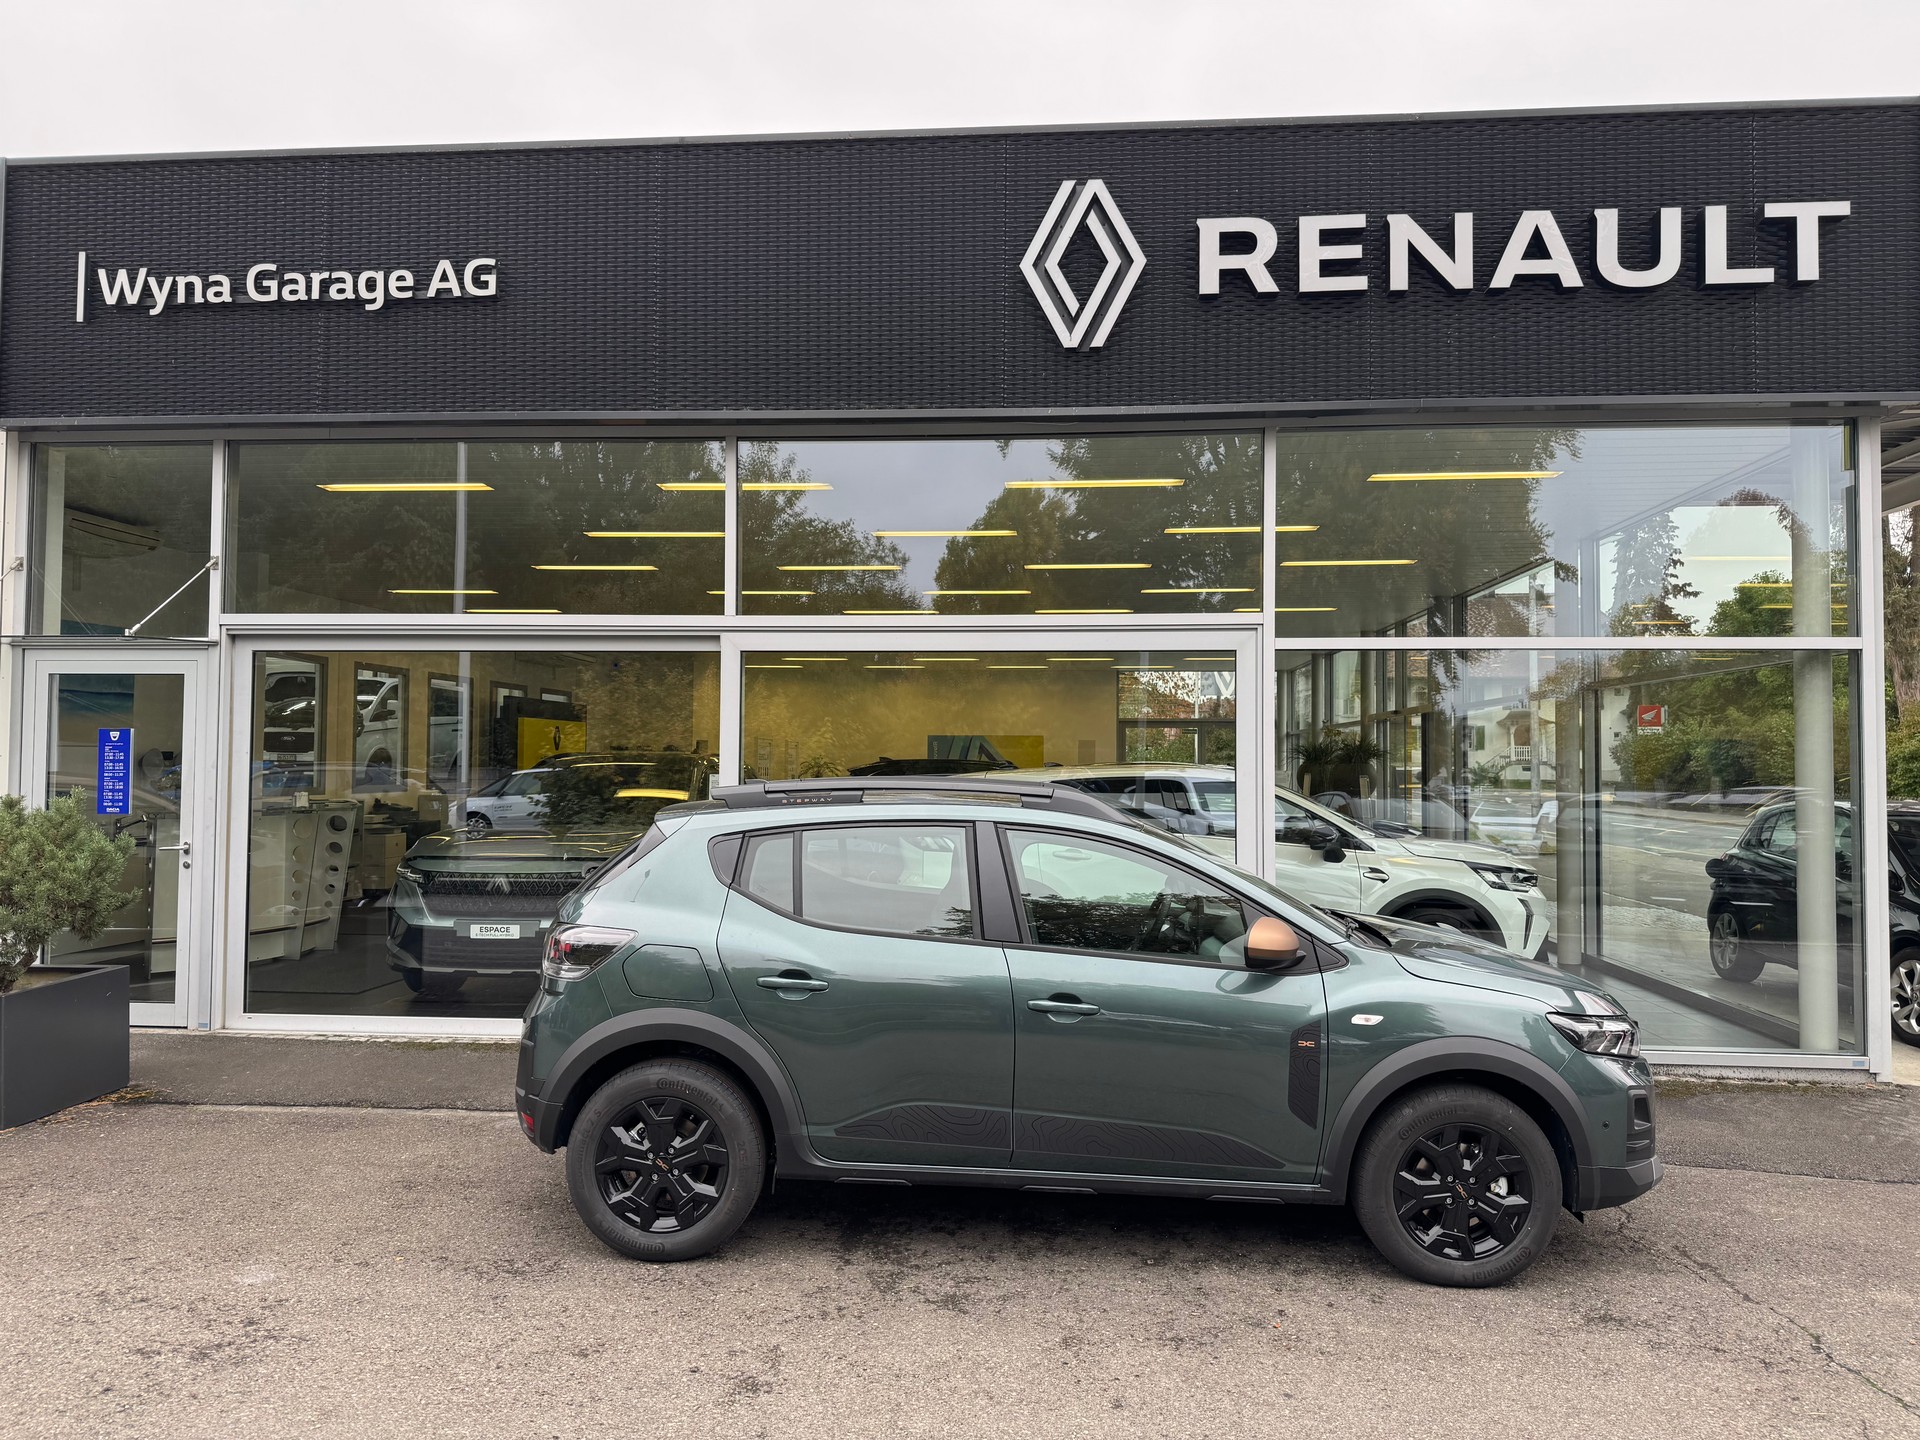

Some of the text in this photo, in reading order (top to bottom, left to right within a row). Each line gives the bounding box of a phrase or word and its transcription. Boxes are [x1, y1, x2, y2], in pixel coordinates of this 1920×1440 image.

[1197, 200, 1851, 295] RENAULT
[97, 257, 497, 316] Wyna Garage AG
[656, 1077, 718, 1104] Continental
[1398, 1105, 1459, 1140] Continental
